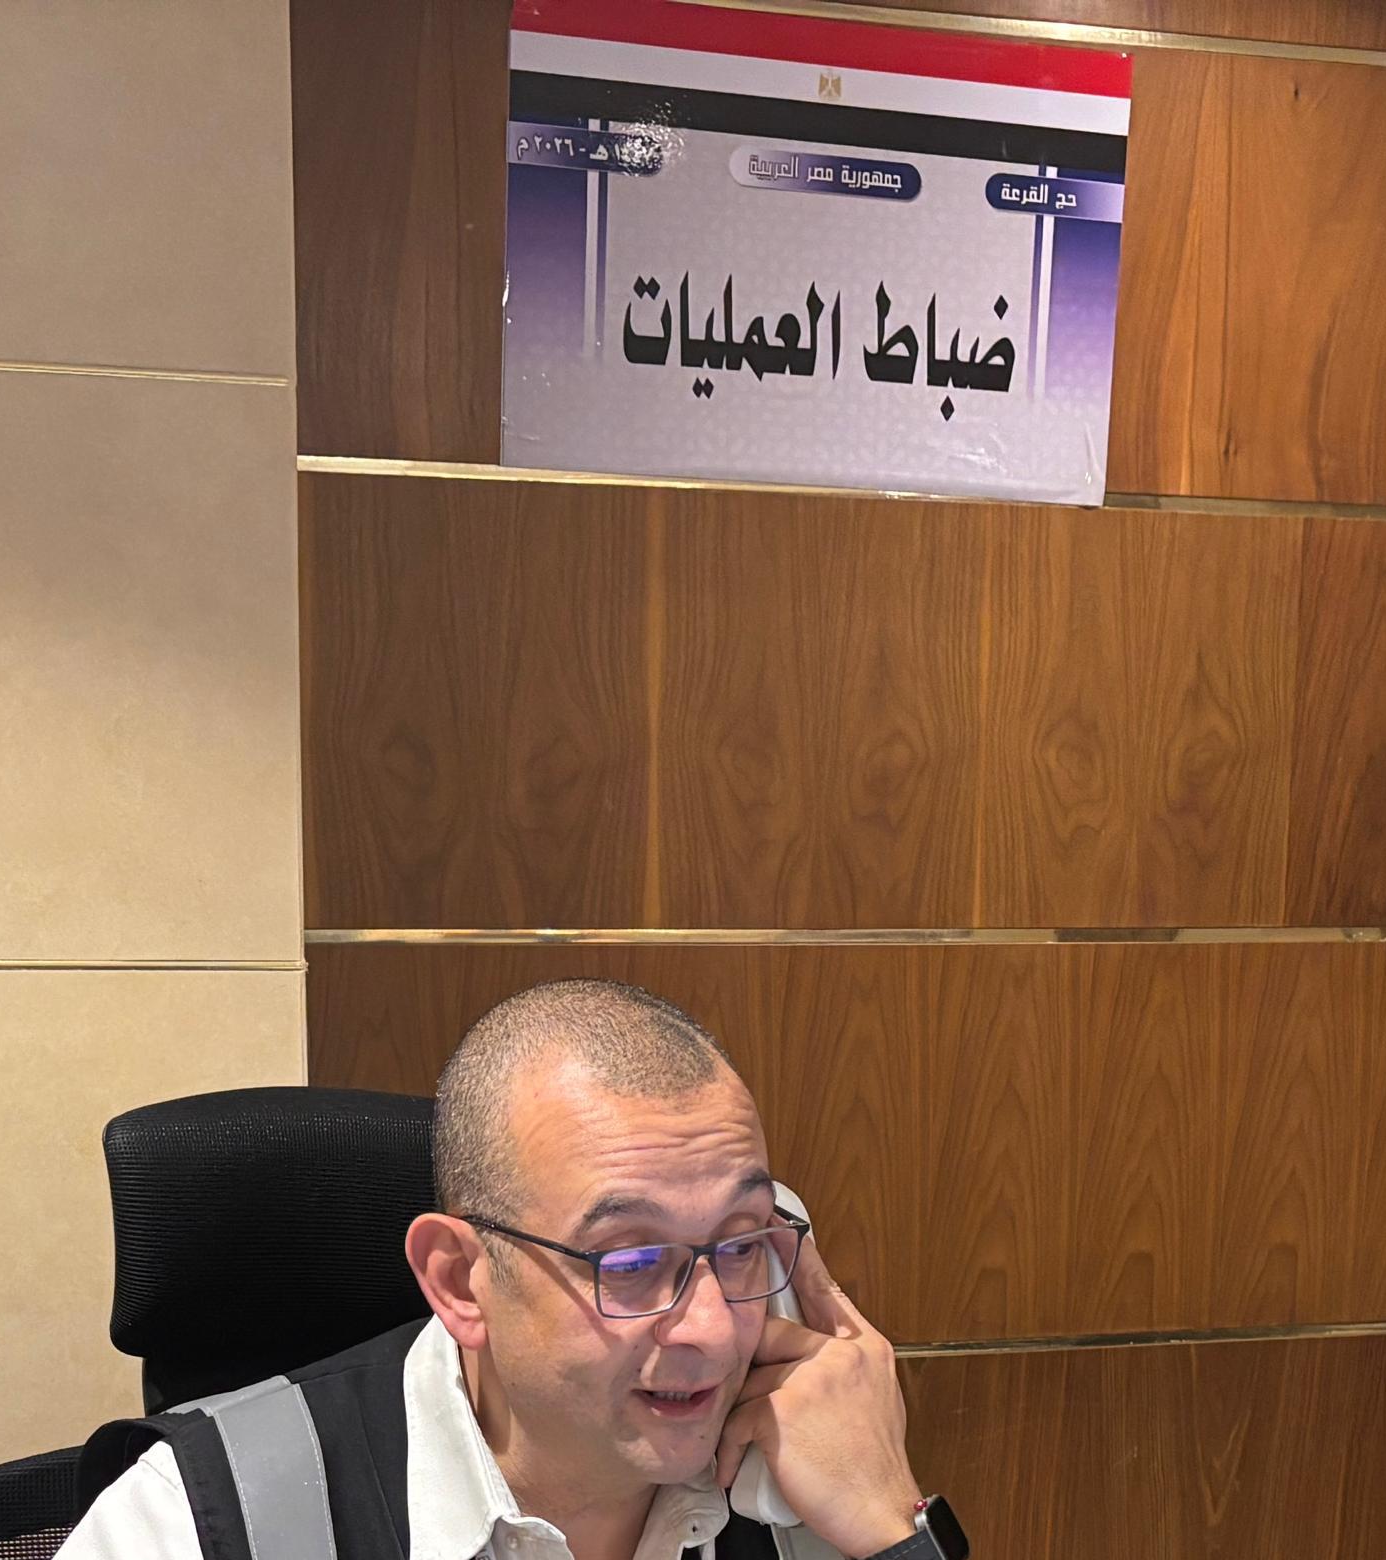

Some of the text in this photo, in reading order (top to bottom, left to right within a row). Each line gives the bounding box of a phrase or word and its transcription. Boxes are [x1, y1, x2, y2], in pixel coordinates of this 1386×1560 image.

[516, 137, 529, 161] م
[533, 134, 575, 157] ٢٠٢٦
[748, 154, 902, 193] جمهورية مصر العربية
[1000, 182, 1078, 210] حج القرعة
[622, 269, 1016, 423] ضباط العمليات
